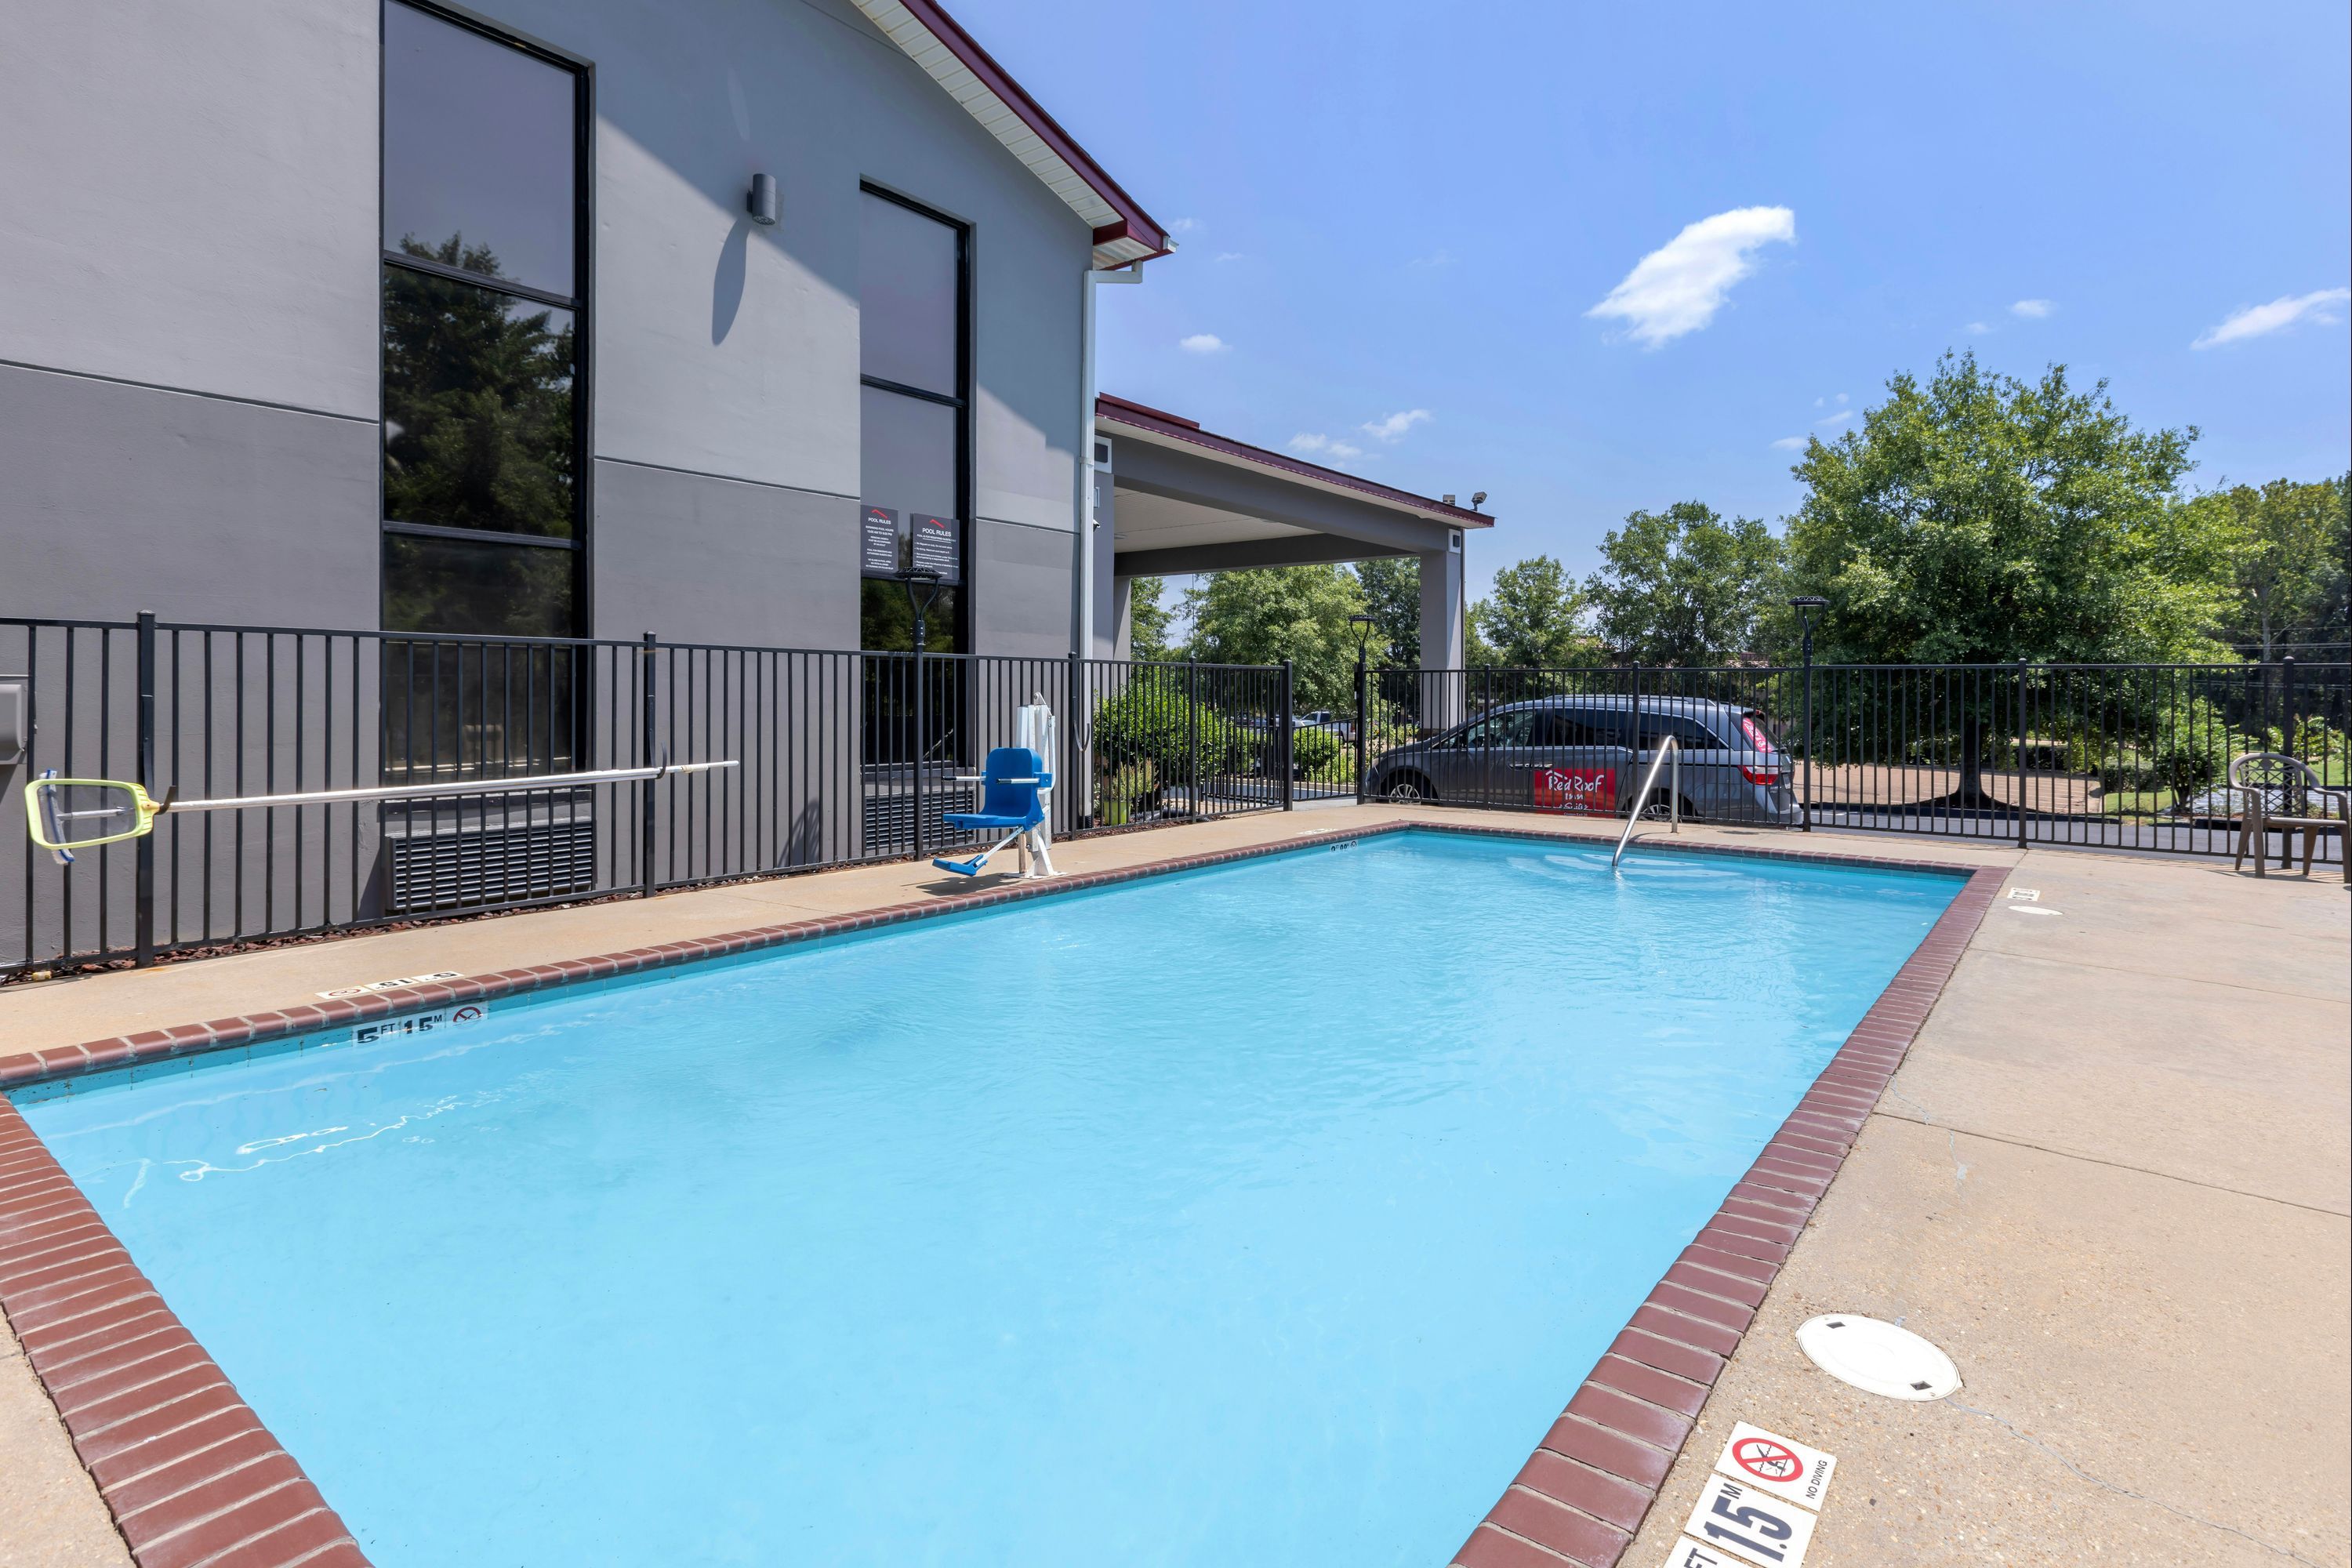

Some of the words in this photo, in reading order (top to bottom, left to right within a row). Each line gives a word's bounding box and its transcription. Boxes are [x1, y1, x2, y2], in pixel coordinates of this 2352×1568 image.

[1548, 775, 1572, 791] Red
[1812, 1460, 1828, 1486] DIVING
[1806, 1486, 1819, 1499] NO
